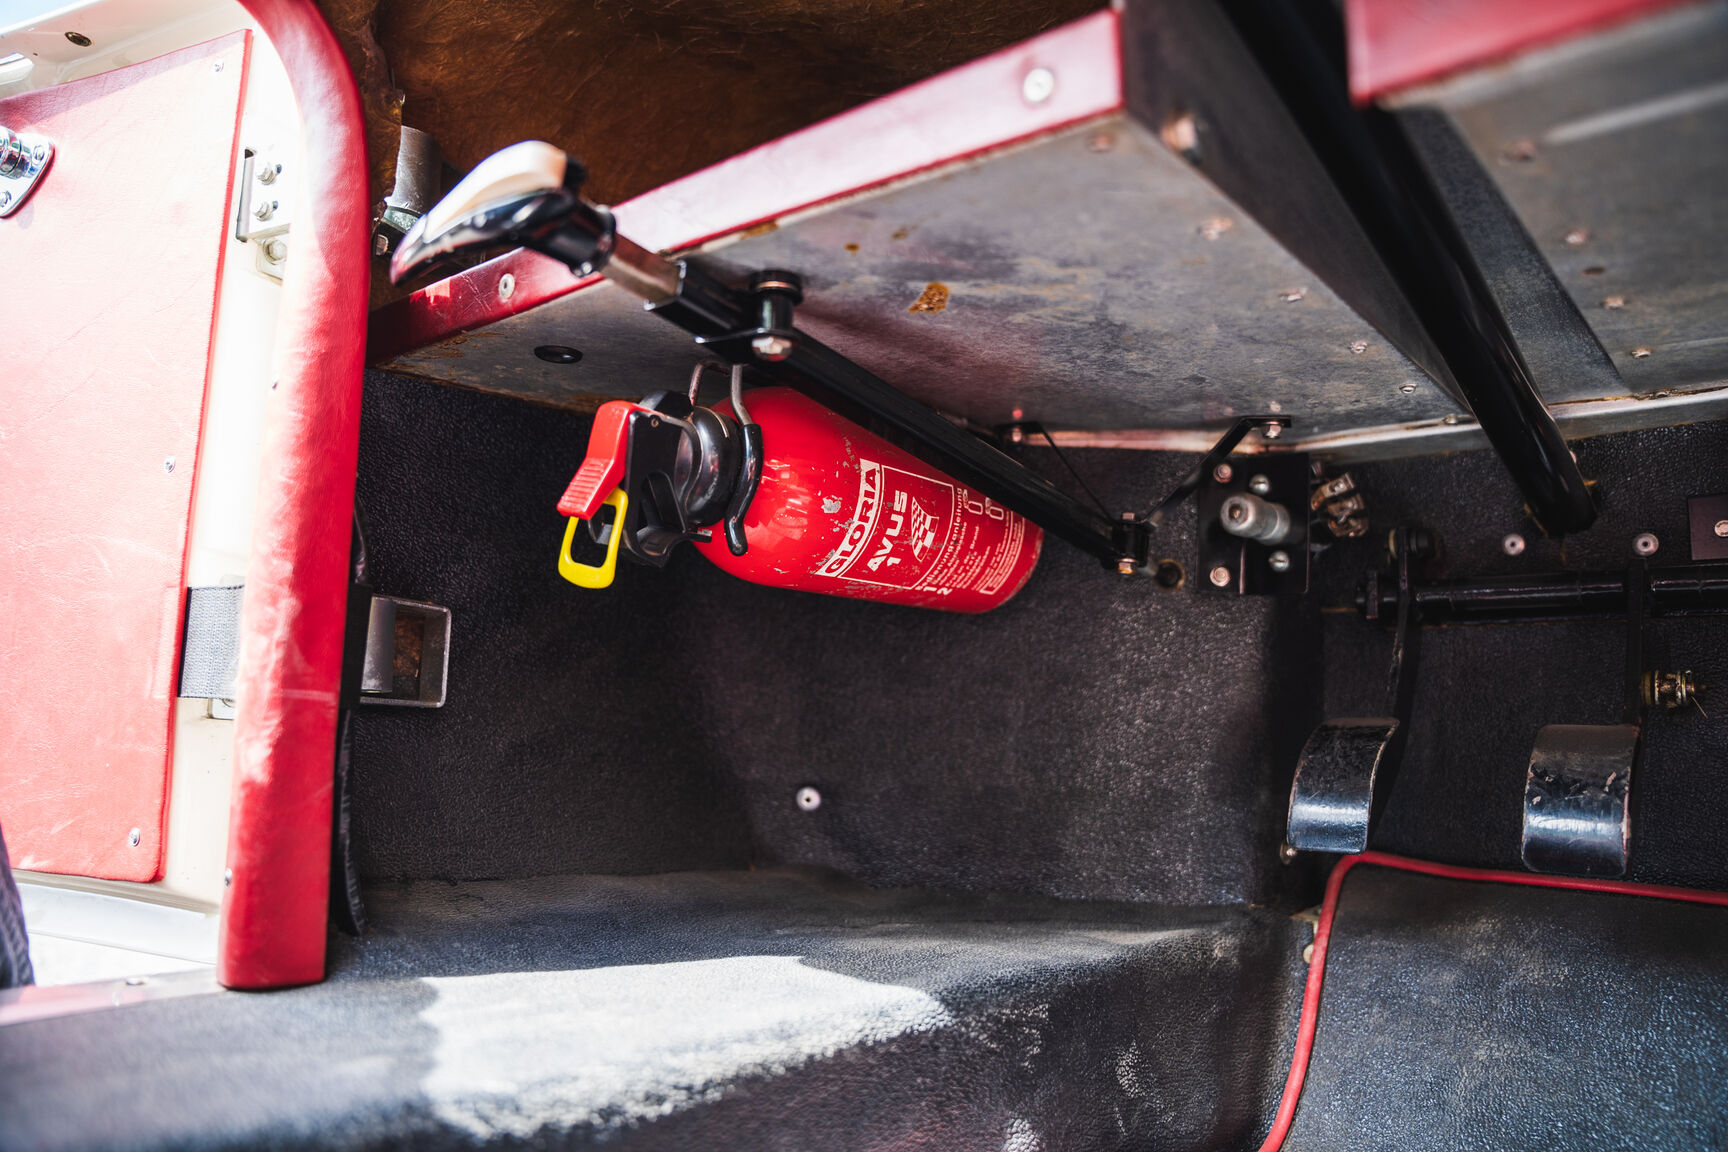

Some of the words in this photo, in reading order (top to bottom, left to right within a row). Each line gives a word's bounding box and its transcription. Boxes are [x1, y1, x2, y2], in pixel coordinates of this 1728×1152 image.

[824, 467, 877, 574] GLORIA
[866, 489, 908, 572] AVUS
[936, 587, 953, 596] 2
